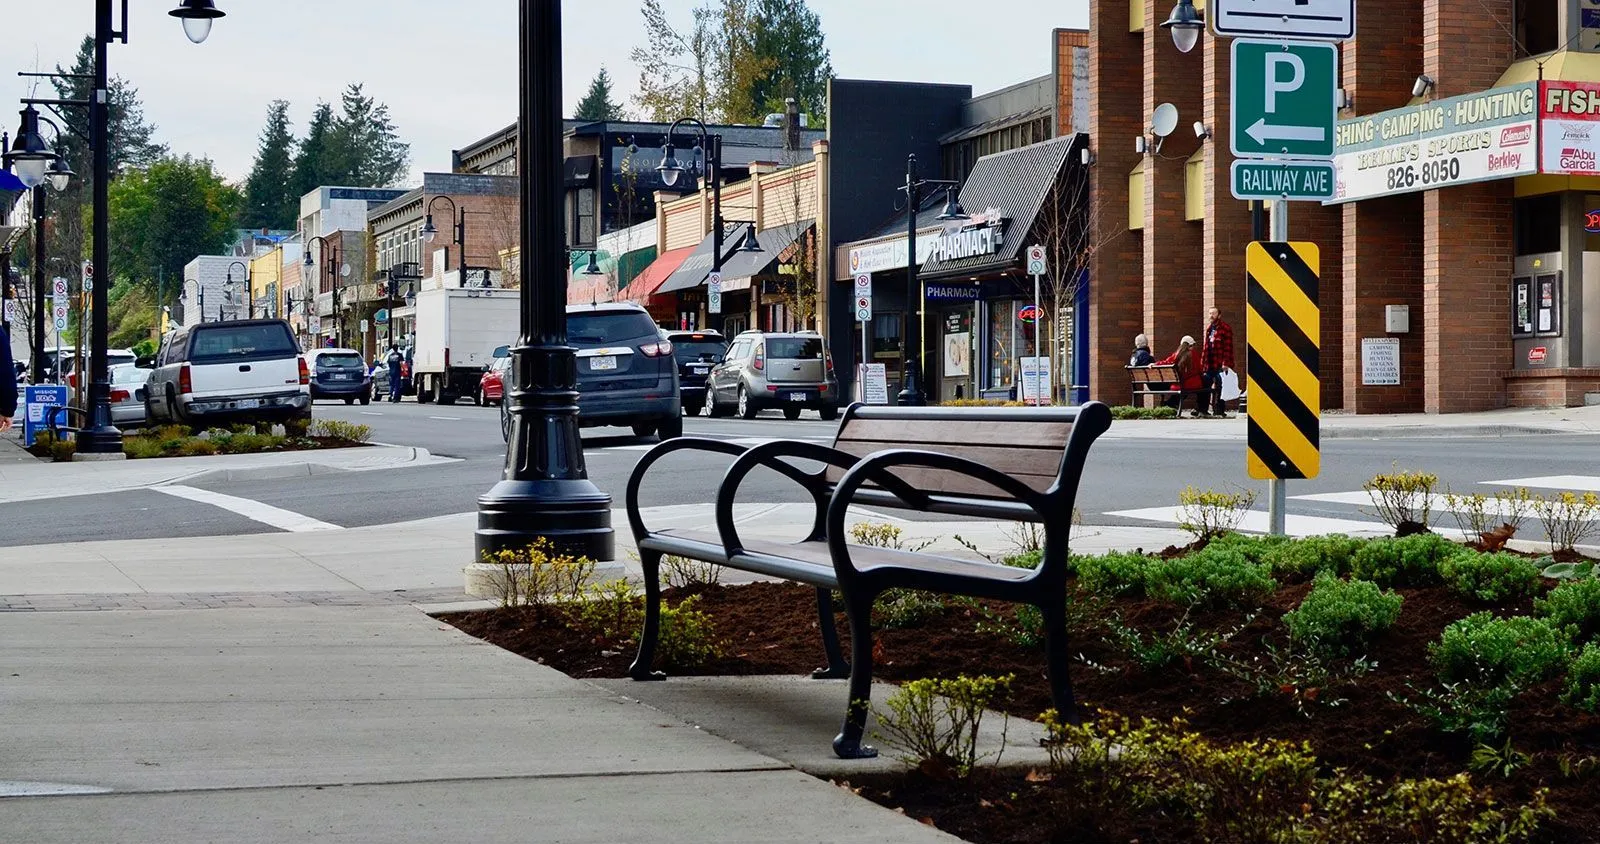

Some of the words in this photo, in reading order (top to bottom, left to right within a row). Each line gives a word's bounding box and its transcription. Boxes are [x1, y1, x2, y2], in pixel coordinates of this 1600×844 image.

[1265, 52, 1306, 114] P
[1336, 120, 1375, 147] SHING
[1381, 106, 1444, 140] CAMPING
[1454, 88, 1534, 126] HUNTING
[1357, 143, 1420, 171] BELLE'S
[1427, 130, 1492, 158] SPORTS
[1487, 151, 1522, 171] Berkley
[1560, 158, 1596, 170] Garcia
[1573, 148, 1596, 160] Abu
[1242, 168, 1299, 192] RAILWAY
[1303, 170, 1328, 192] AVE
[1387, 157, 1460, 191] 826-8050
[933, 228, 993, 261] PHARMACY
[927, 286, 982, 299] PHARMACY
